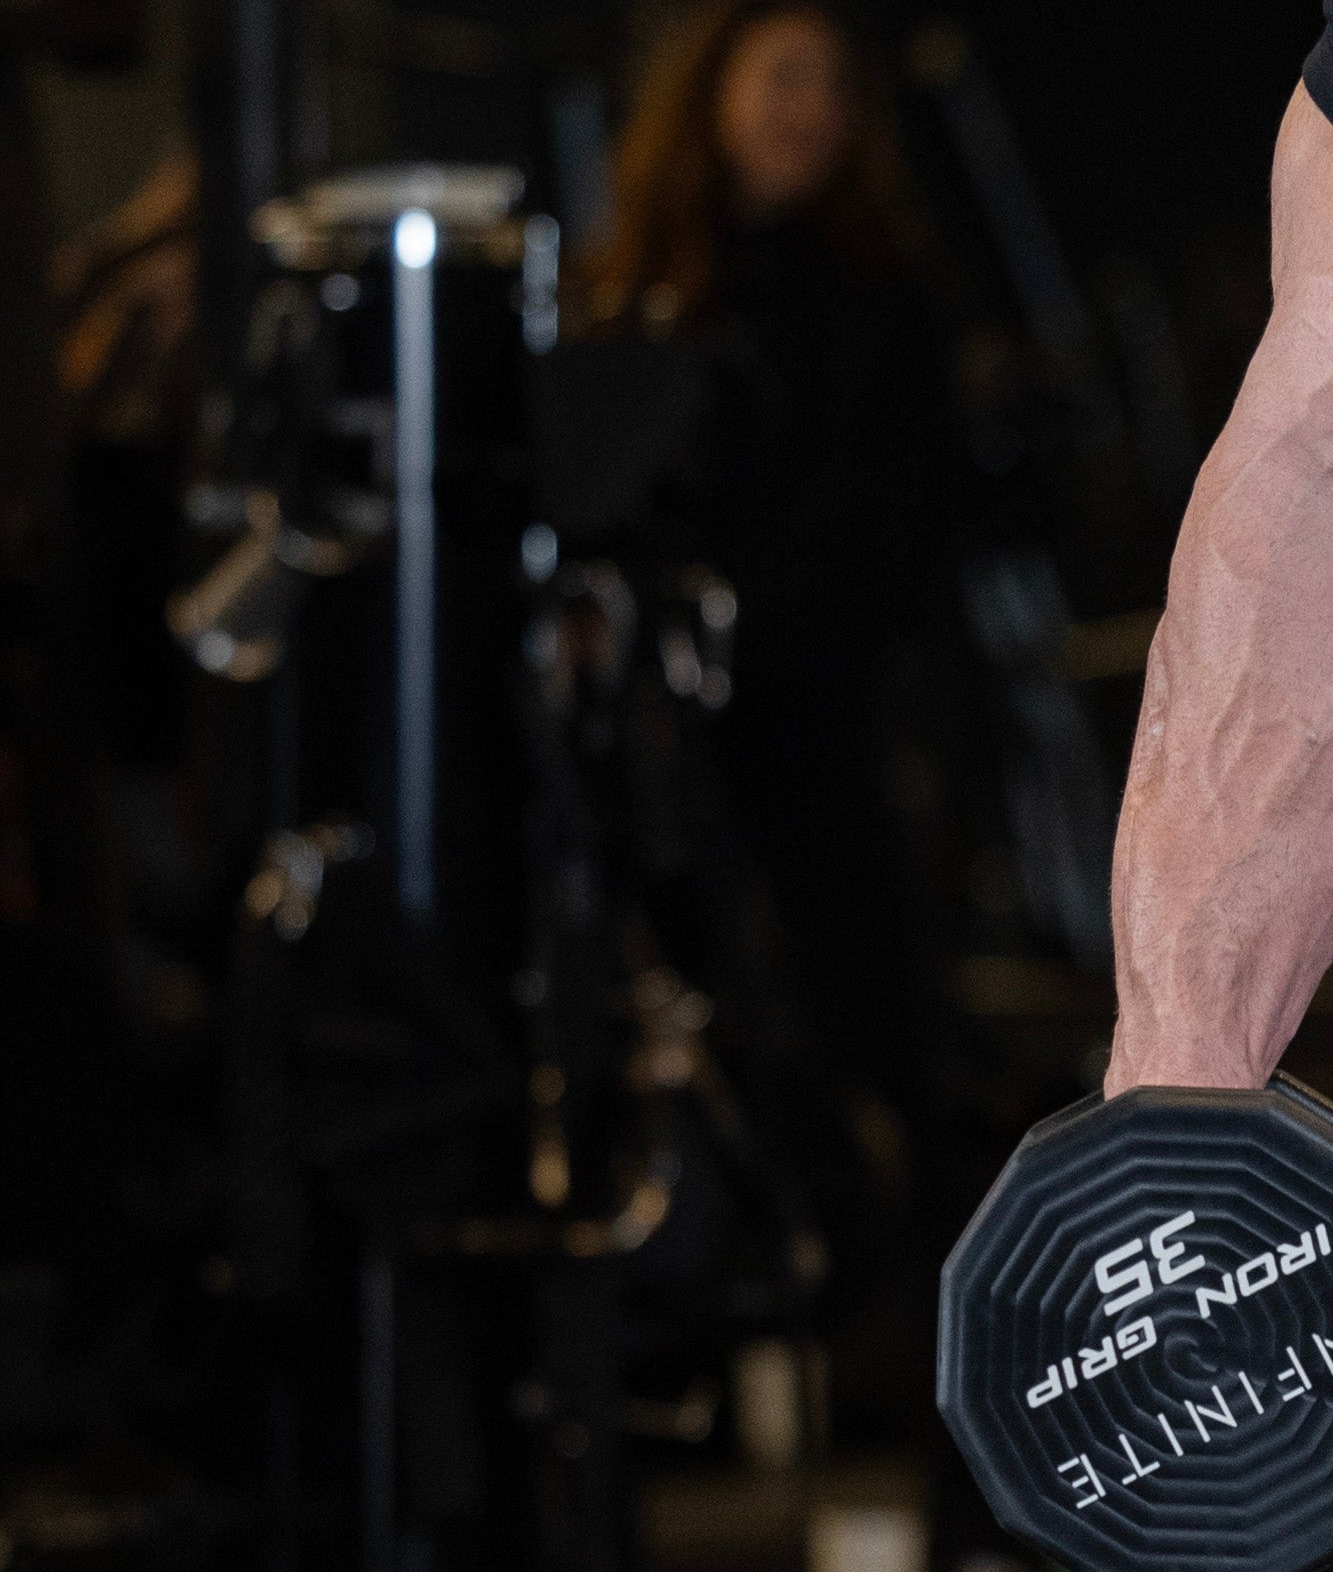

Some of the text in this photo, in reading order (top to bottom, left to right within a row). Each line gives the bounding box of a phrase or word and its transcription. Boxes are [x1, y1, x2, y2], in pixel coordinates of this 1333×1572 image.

[1026, 1223, 1332, 1409] IRON GRIP
[1093, 1209, 1206, 1317] 35
